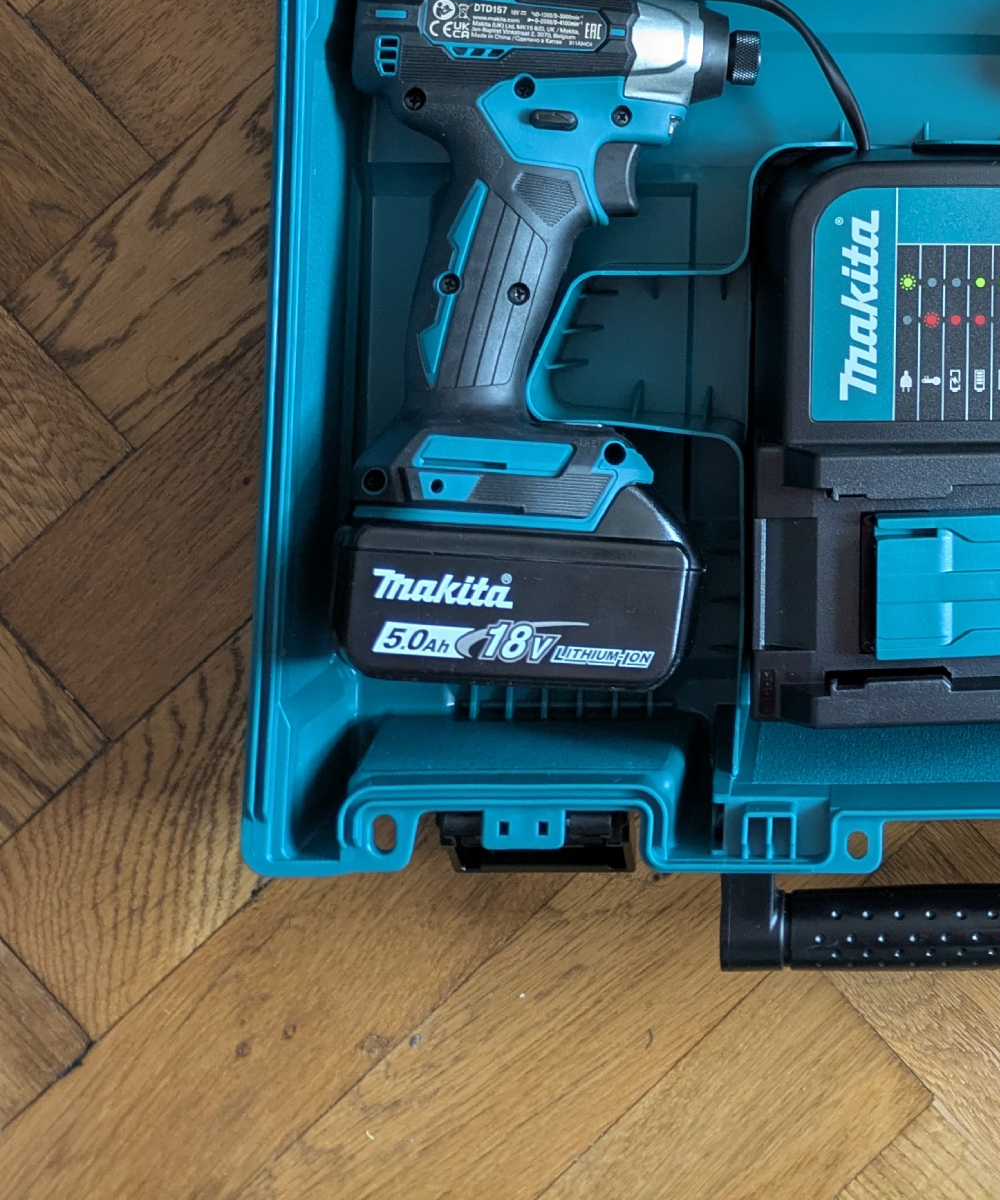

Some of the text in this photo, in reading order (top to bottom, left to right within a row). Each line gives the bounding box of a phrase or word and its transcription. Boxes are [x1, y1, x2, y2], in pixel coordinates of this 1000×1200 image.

[473, 3, 508, 14] DTD157
[472, 15, 521, 24] www.makita.com
[472, 20, 492, 28] Makita
[453, 21, 471, 31] UK
[452, 30, 470, 39] CA
[584, 22, 603, 40] EAC
[553, 33, 577, 41] Belgium
[383, 619, 655, 669] 5.0Ah 18V LITHIUM-ION
